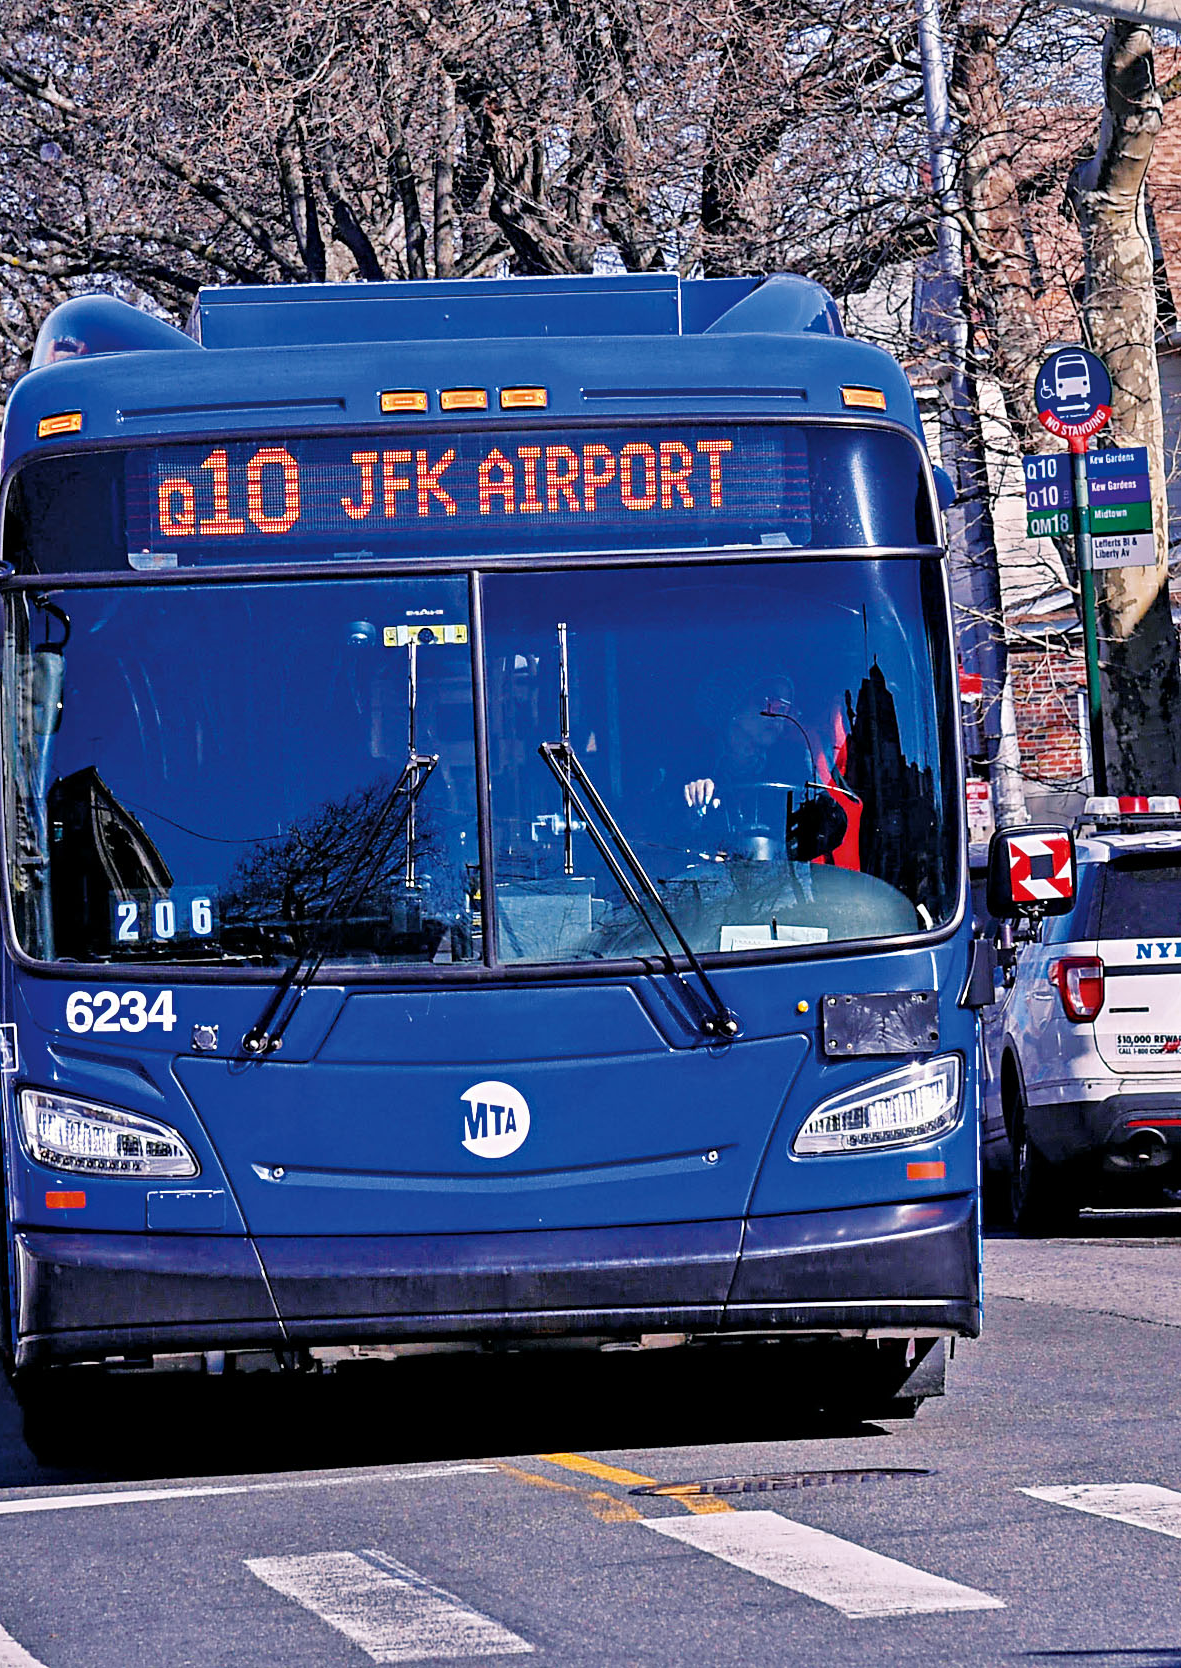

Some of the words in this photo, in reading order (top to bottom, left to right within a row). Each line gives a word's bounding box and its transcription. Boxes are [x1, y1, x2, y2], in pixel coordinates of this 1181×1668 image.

[1045, 416, 1060, 432] NO
[1061, 409, 1106, 436] STANDING
[1090, 455, 1104, 464] Kew
[1105, 453, 1135, 463] Gardens
[1027, 459, 1057, 480] Q10
[158, 447, 300, 536] Q10
[341, 449, 456, 520] JFK
[478, 440, 733, 515] AIRPORT
[1091, 482, 1106, 492] Kew
[1107, 480, 1137, 490] Gardens
[1029, 486, 1059, 508] Q10
[1031, 513, 1069, 535] QM18
[1094, 508, 1127, 519] Midtown
[1095, 538, 1121, 548] Lefferts
[1132, 536, 1138, 546] &
[1095, 550, 1119, 560] Liberty
[1121, 548, 1130, 557] Av
[65, 990, 177, 1033] 6234
[1117, 1034, 1152, 1047] $10,000
[1154, 1034, 1181, 1044] REWA
[462, 1100, 518, 1143] MTA
